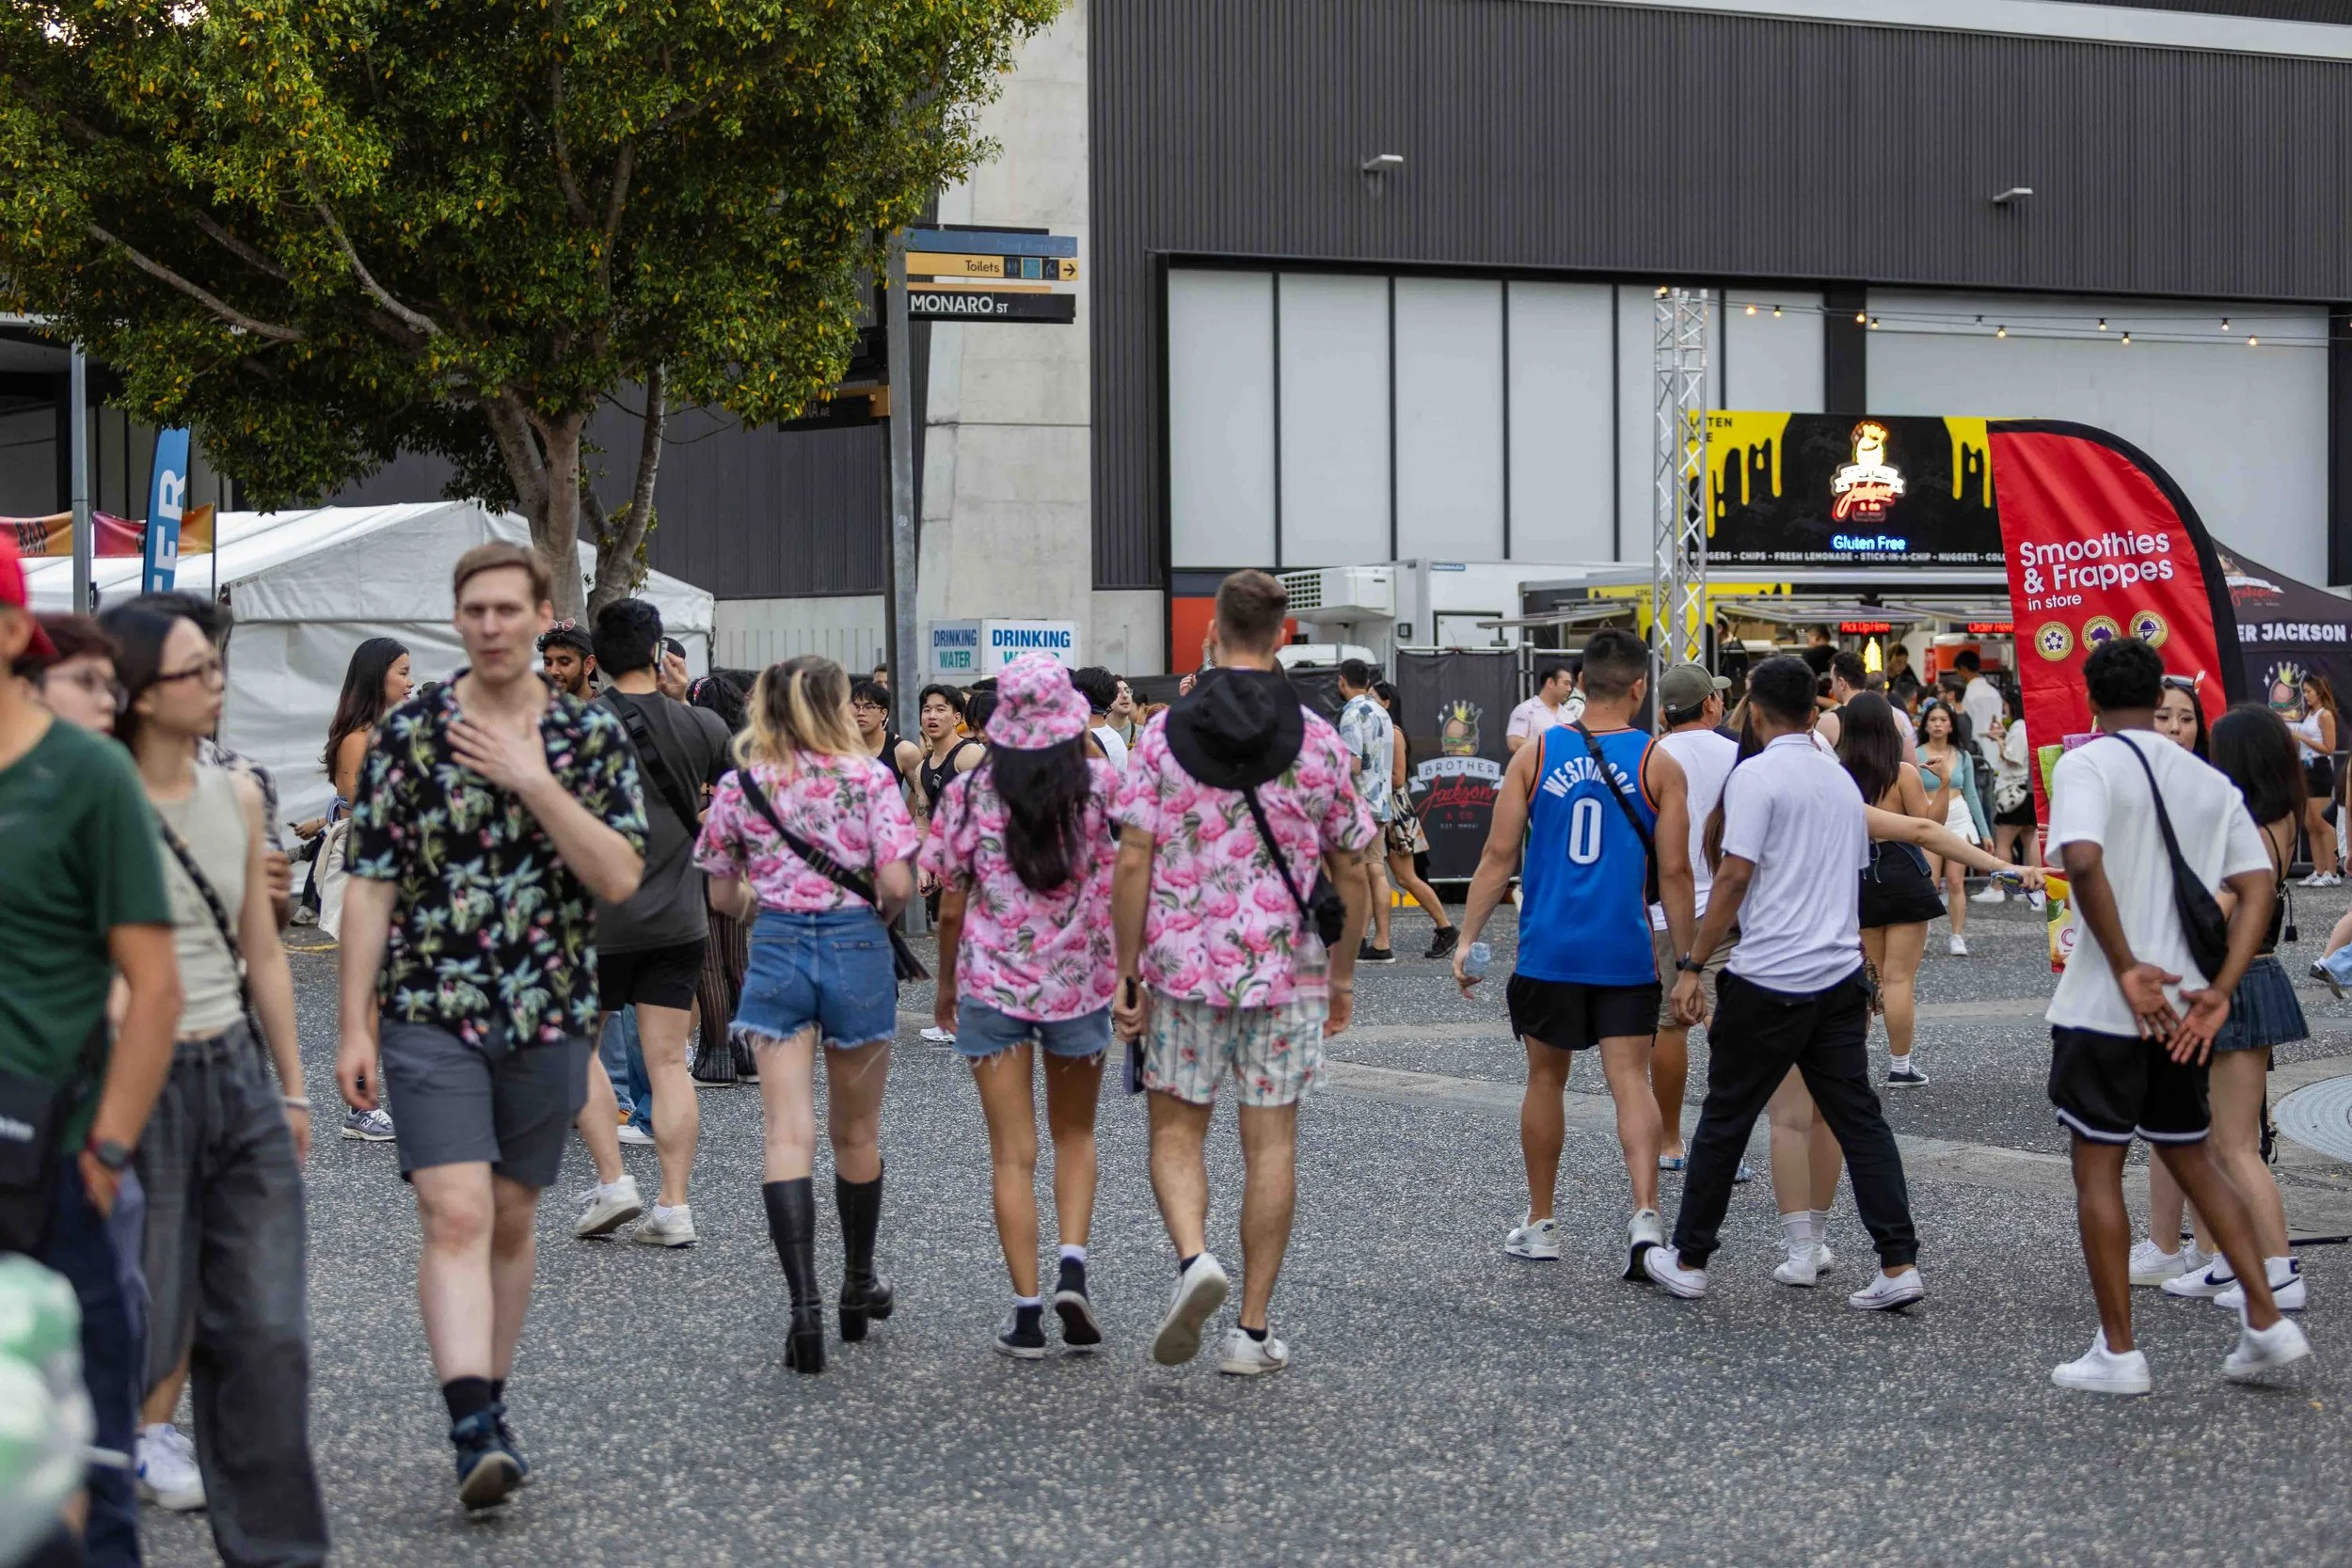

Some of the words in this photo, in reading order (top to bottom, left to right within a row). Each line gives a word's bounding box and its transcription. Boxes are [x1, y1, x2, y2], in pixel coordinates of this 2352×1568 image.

[965, 260, 1000, 273] Toilets
[911, 294, 993, 314] MONARO
[995, 303, 1009, 314] ST
[803, 402, 819, 419] NA
[153, 469, 186, 592] ER
[1833, 535, 1876, 550] Gluten
[1877, 535, 1906, 550] Free
[2019, 530, 2170, 567] Smoothies
[1690, 551, 1732, 562] BGERS
[1739, 551, 1766, 562] CHIPS
[1773, 551, 1803, 562] FRESH
[1804, 551, 1852, 562] LEMONADE
[1938, 552, 1979, 562] NUGGETS
[2024, 567, 2045, 594] &
[2052, 559, 2174, 591] Frappes
[2027, 597, 2042, 611] in
[2045, 594, 2082, 609] store
[1841, 622, 1857, 633] Pick
[1858, 622, 1870, 635] Up
[1870, 622, 1891, 633] Here
[1967, 622, 1994, 633] Order
[2084, 618, 2106, 641] AUSTRALIAN
[2261, 622, 2346, 642] JACKSON
[933, 628, 977, 647] DRINKING
[993, 629, 1071, 648] DRINKING
[939, 651, 971, 669] WATER
[1424, 759, 1496, 776] BROTHER
[1416, 772, 1499, 823] Jackson
[1568, 797, 1602, 865] 0
